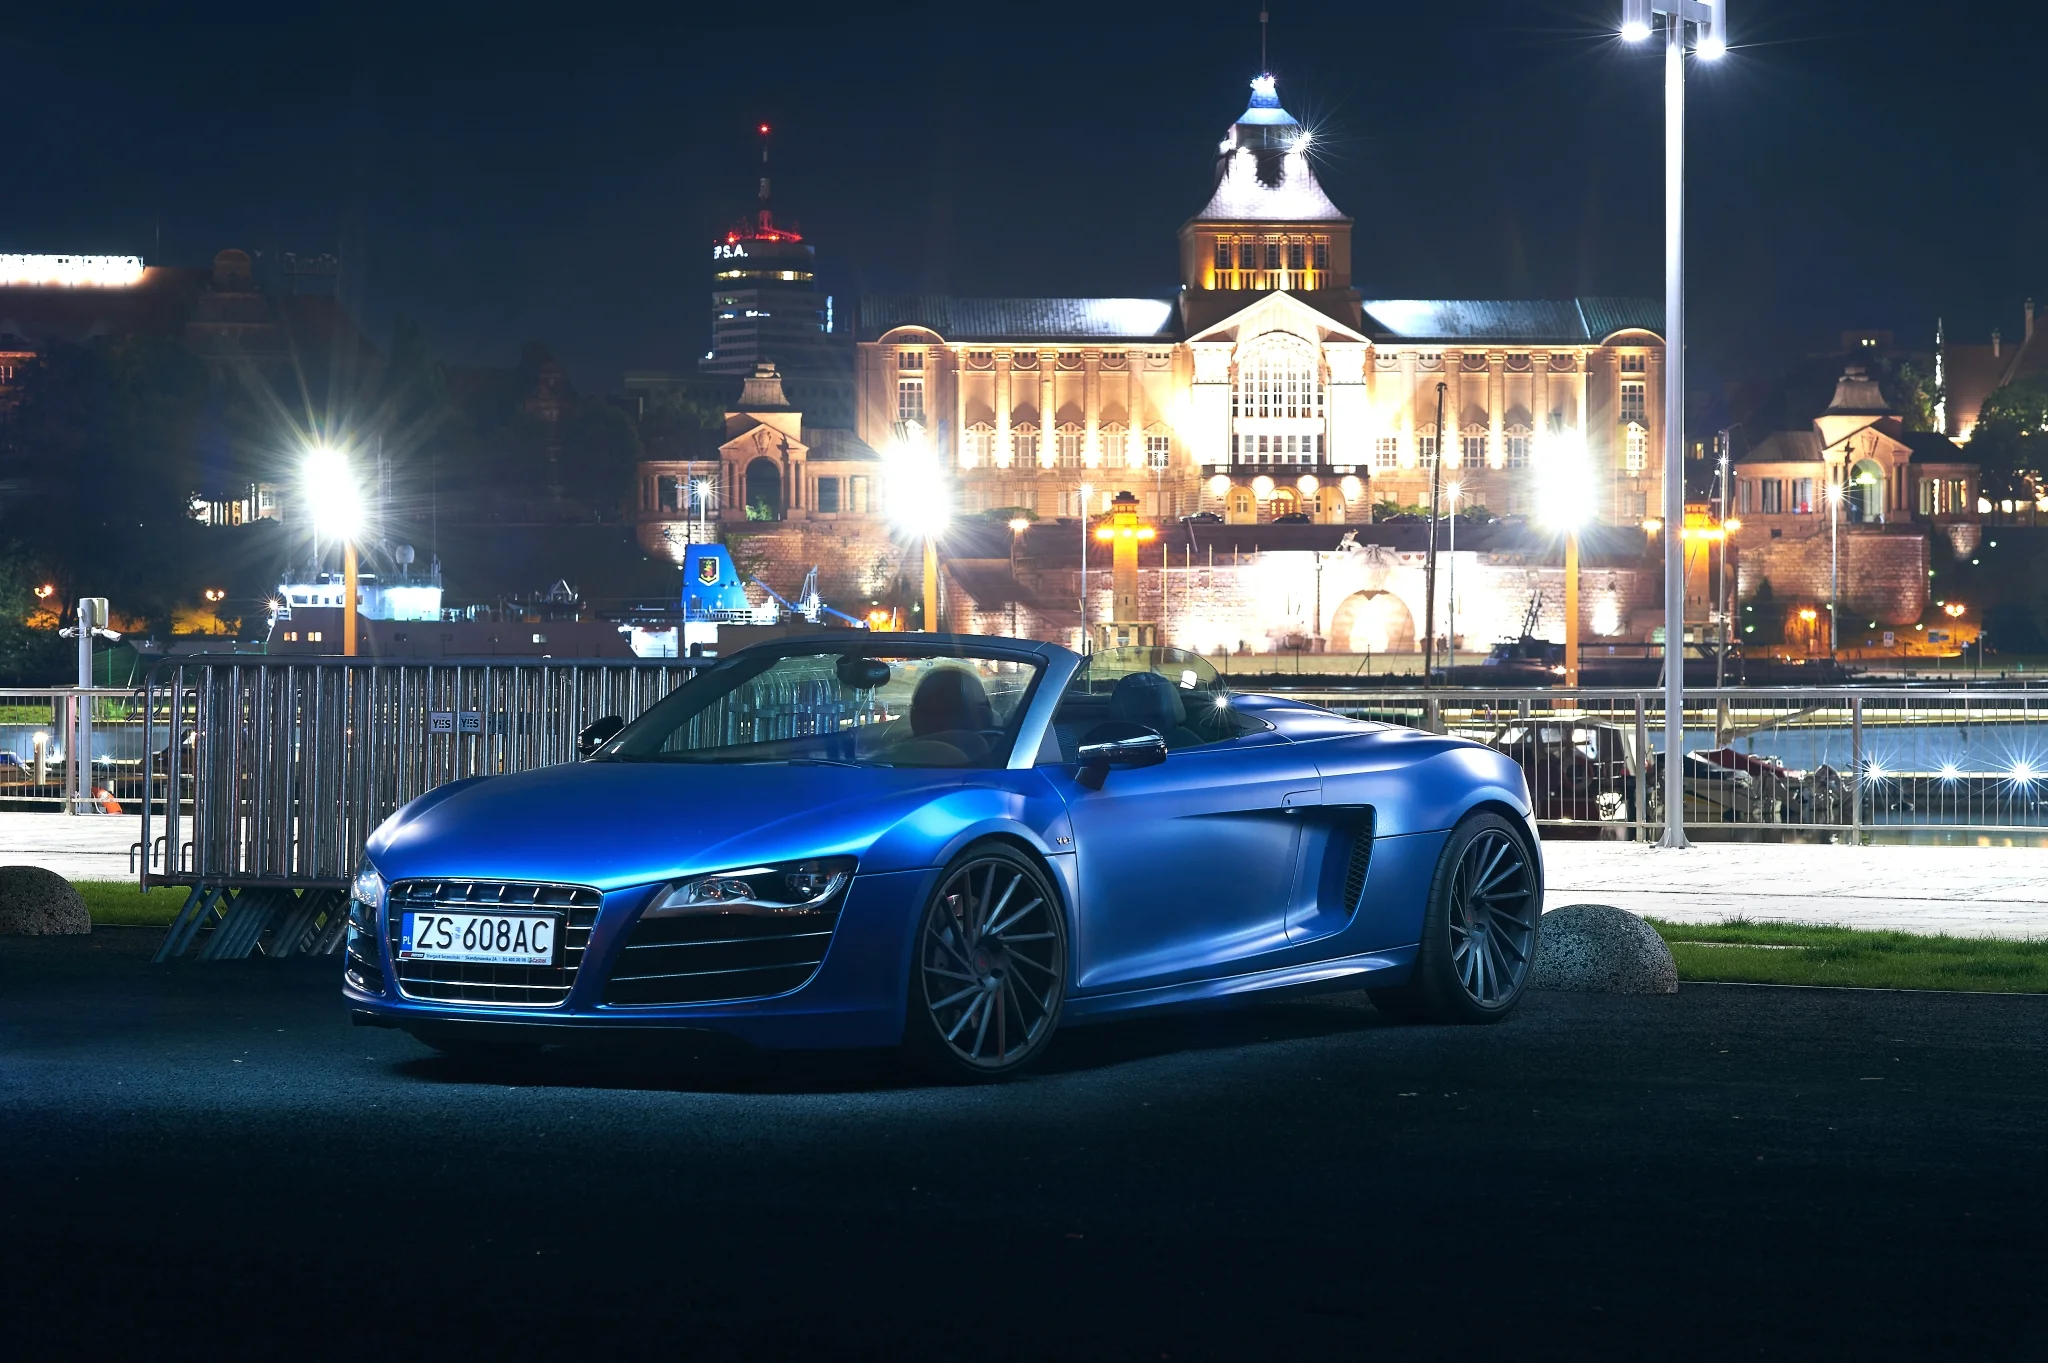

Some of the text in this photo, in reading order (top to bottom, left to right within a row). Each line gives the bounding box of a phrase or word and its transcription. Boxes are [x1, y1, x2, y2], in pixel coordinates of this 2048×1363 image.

[433, 719, 451, 728] YES
[461, 718, 479, 728] YES
[416, 916, 549, 953] ZS 608AC
[402, 935, 412, 944] PL
